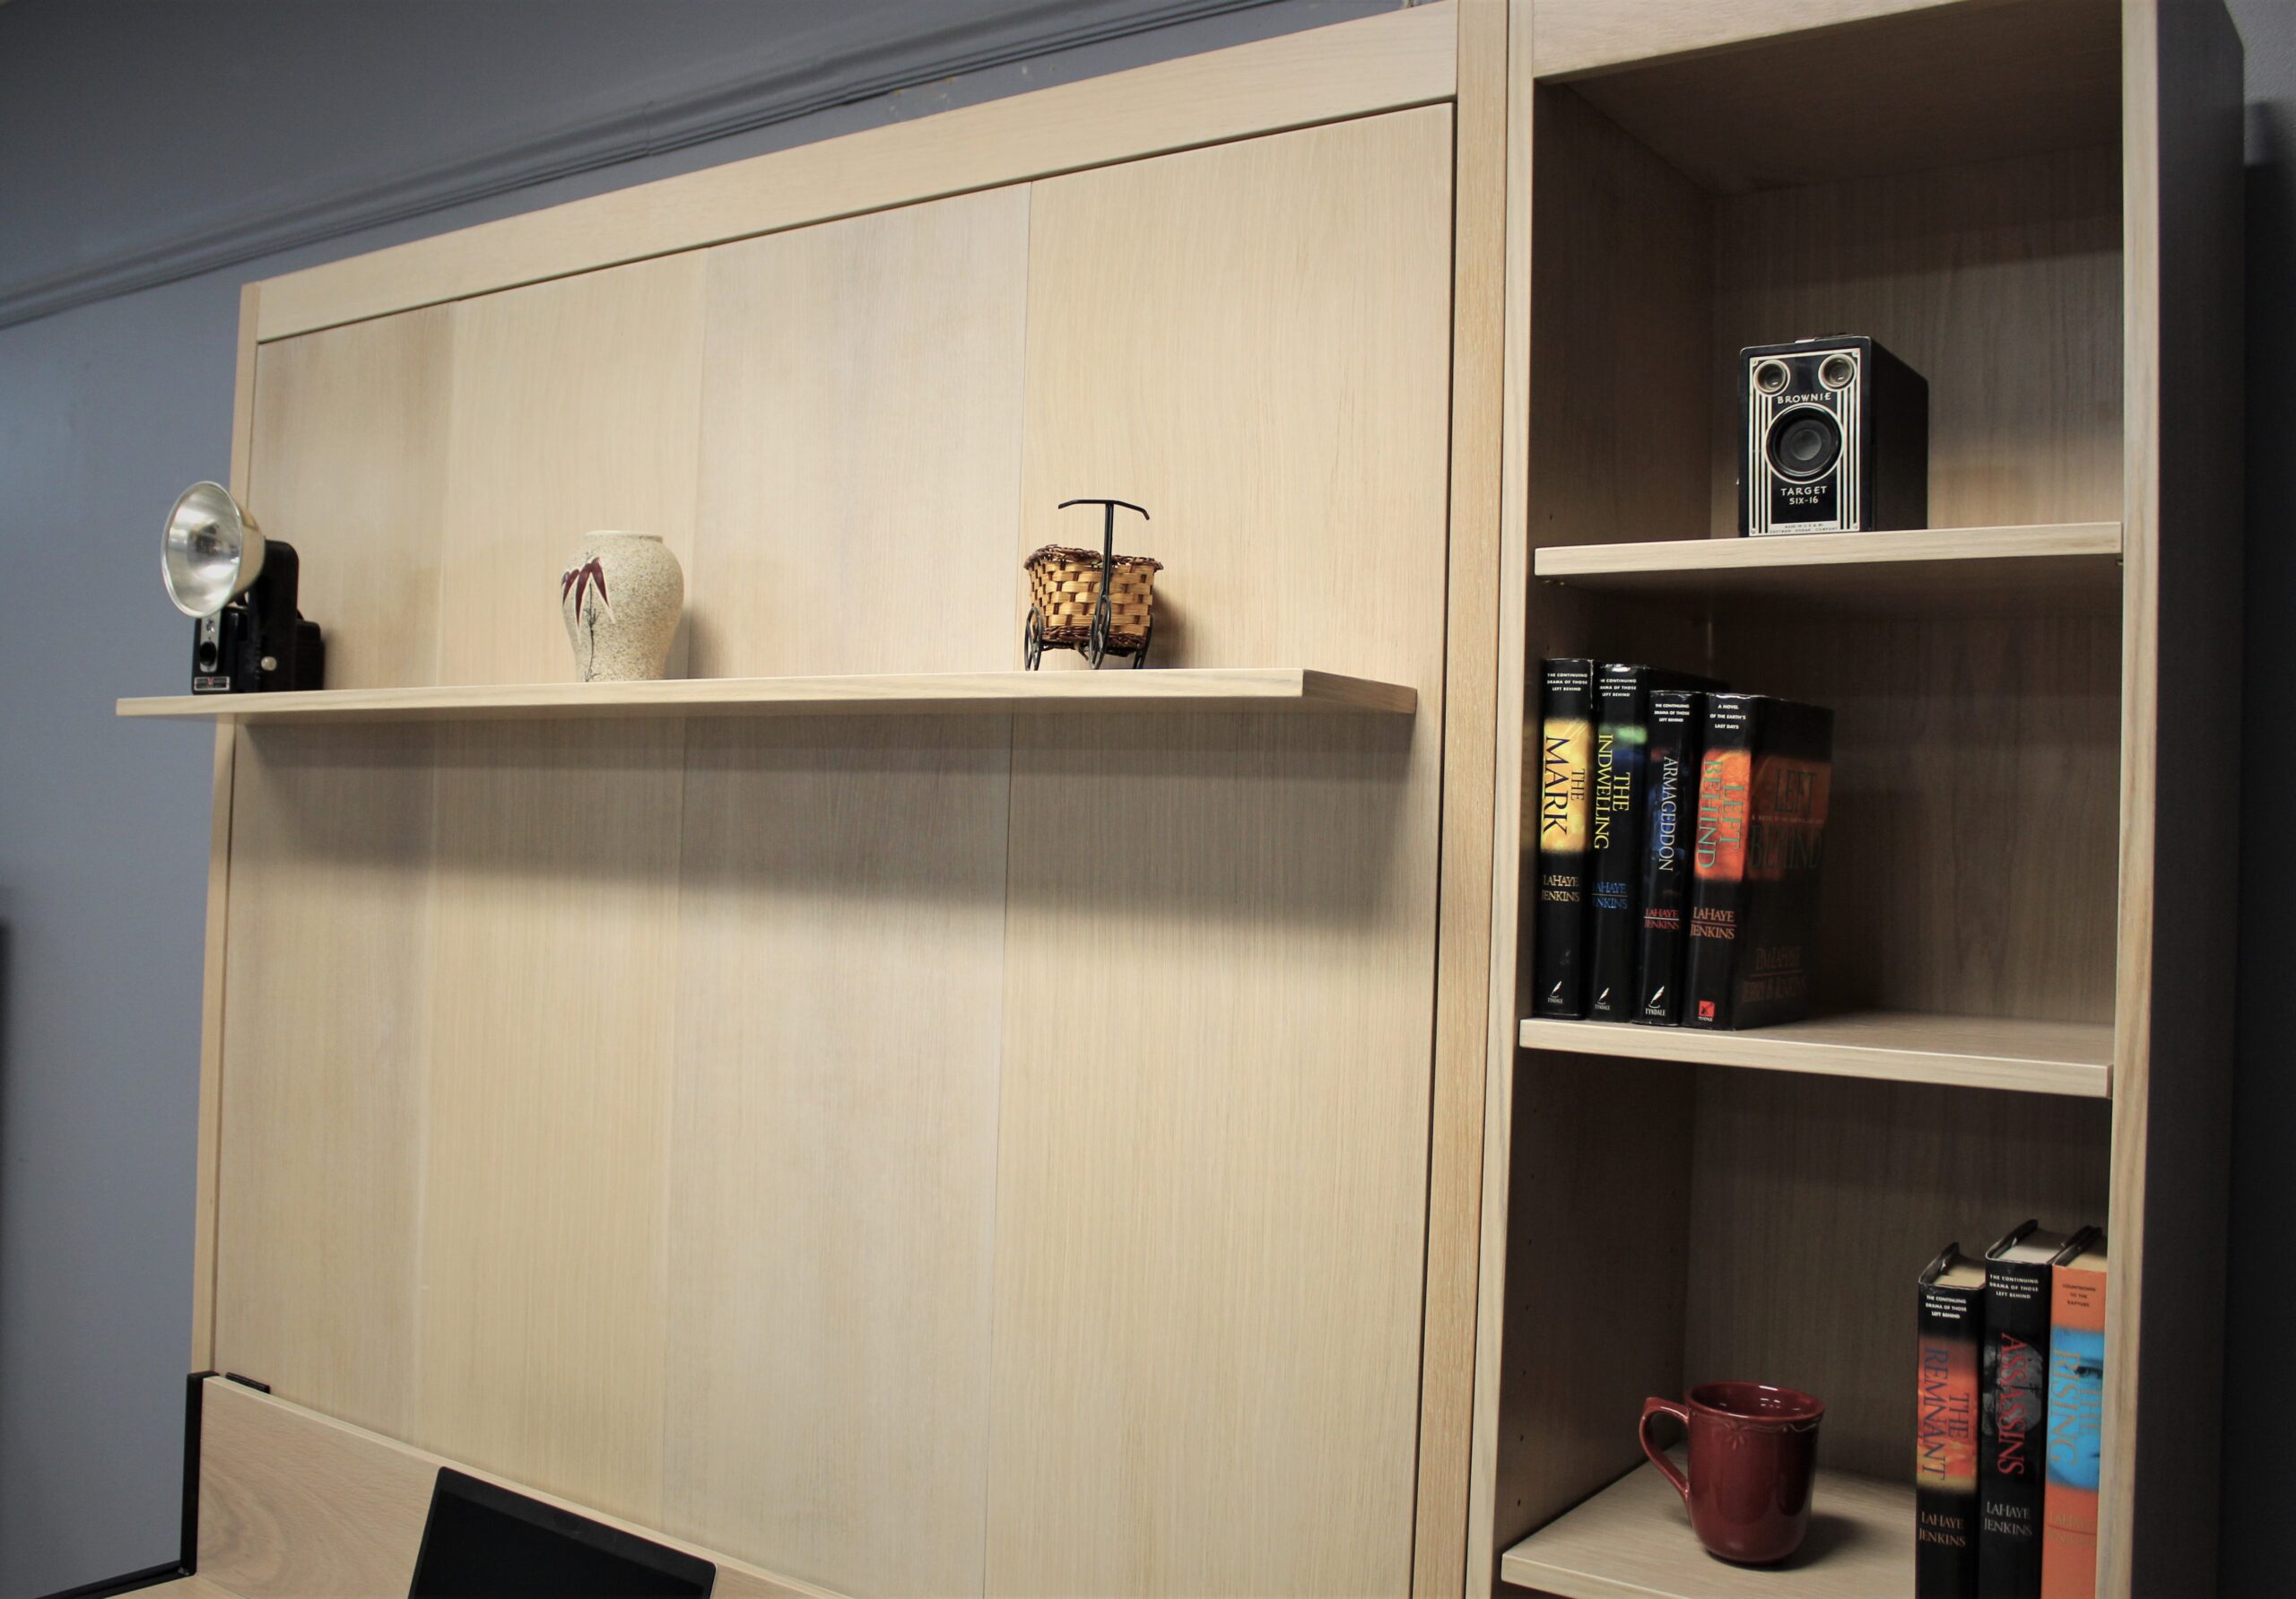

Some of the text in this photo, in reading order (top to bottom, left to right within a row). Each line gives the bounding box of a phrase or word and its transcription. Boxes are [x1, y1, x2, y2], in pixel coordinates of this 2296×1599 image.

[1777, 392, 1831, 404] BROWNIE
[1781, 485, 1827, 496] TARGET
[1789, 496, 1819, 505] SIX-16
[1543, 735, 1570, 835] MARK
[1571, 768, 1586, 801] THE
[1594, 734, 1613, 849] INDWELLING
[1613, 771, 1631, 812] THE
[1658, 756, 1679, 872] ARMAGEDDON
[1697, 760, 1723, 868] BEHIND
[1719, 782, 1744, 851] LEFT
[1689, 924, 1735, 940] JENKINS
[1645, 1007, 1665, 1016] TYNDALE
[1989, 1282, 2009, 1290] DRAMA
[2002, 1275, 2039, 1284] CONTINUING
[1935, 1295, 1966, 1304] CONTINUING
[1922, 1347, 1951, 1481] REMNANT
[1948, 1393, 1970, 1438] THE
[1996, 1333, 2029, 1475] ASSASSINS
[2051, 1348, 2082, 1464] RISING
[2079, 1388, 2102, 1437] THE
[1918, 1527, 1966, 1548] JENKINS
[1984, 1517, 2032, 1536] JENKINS
